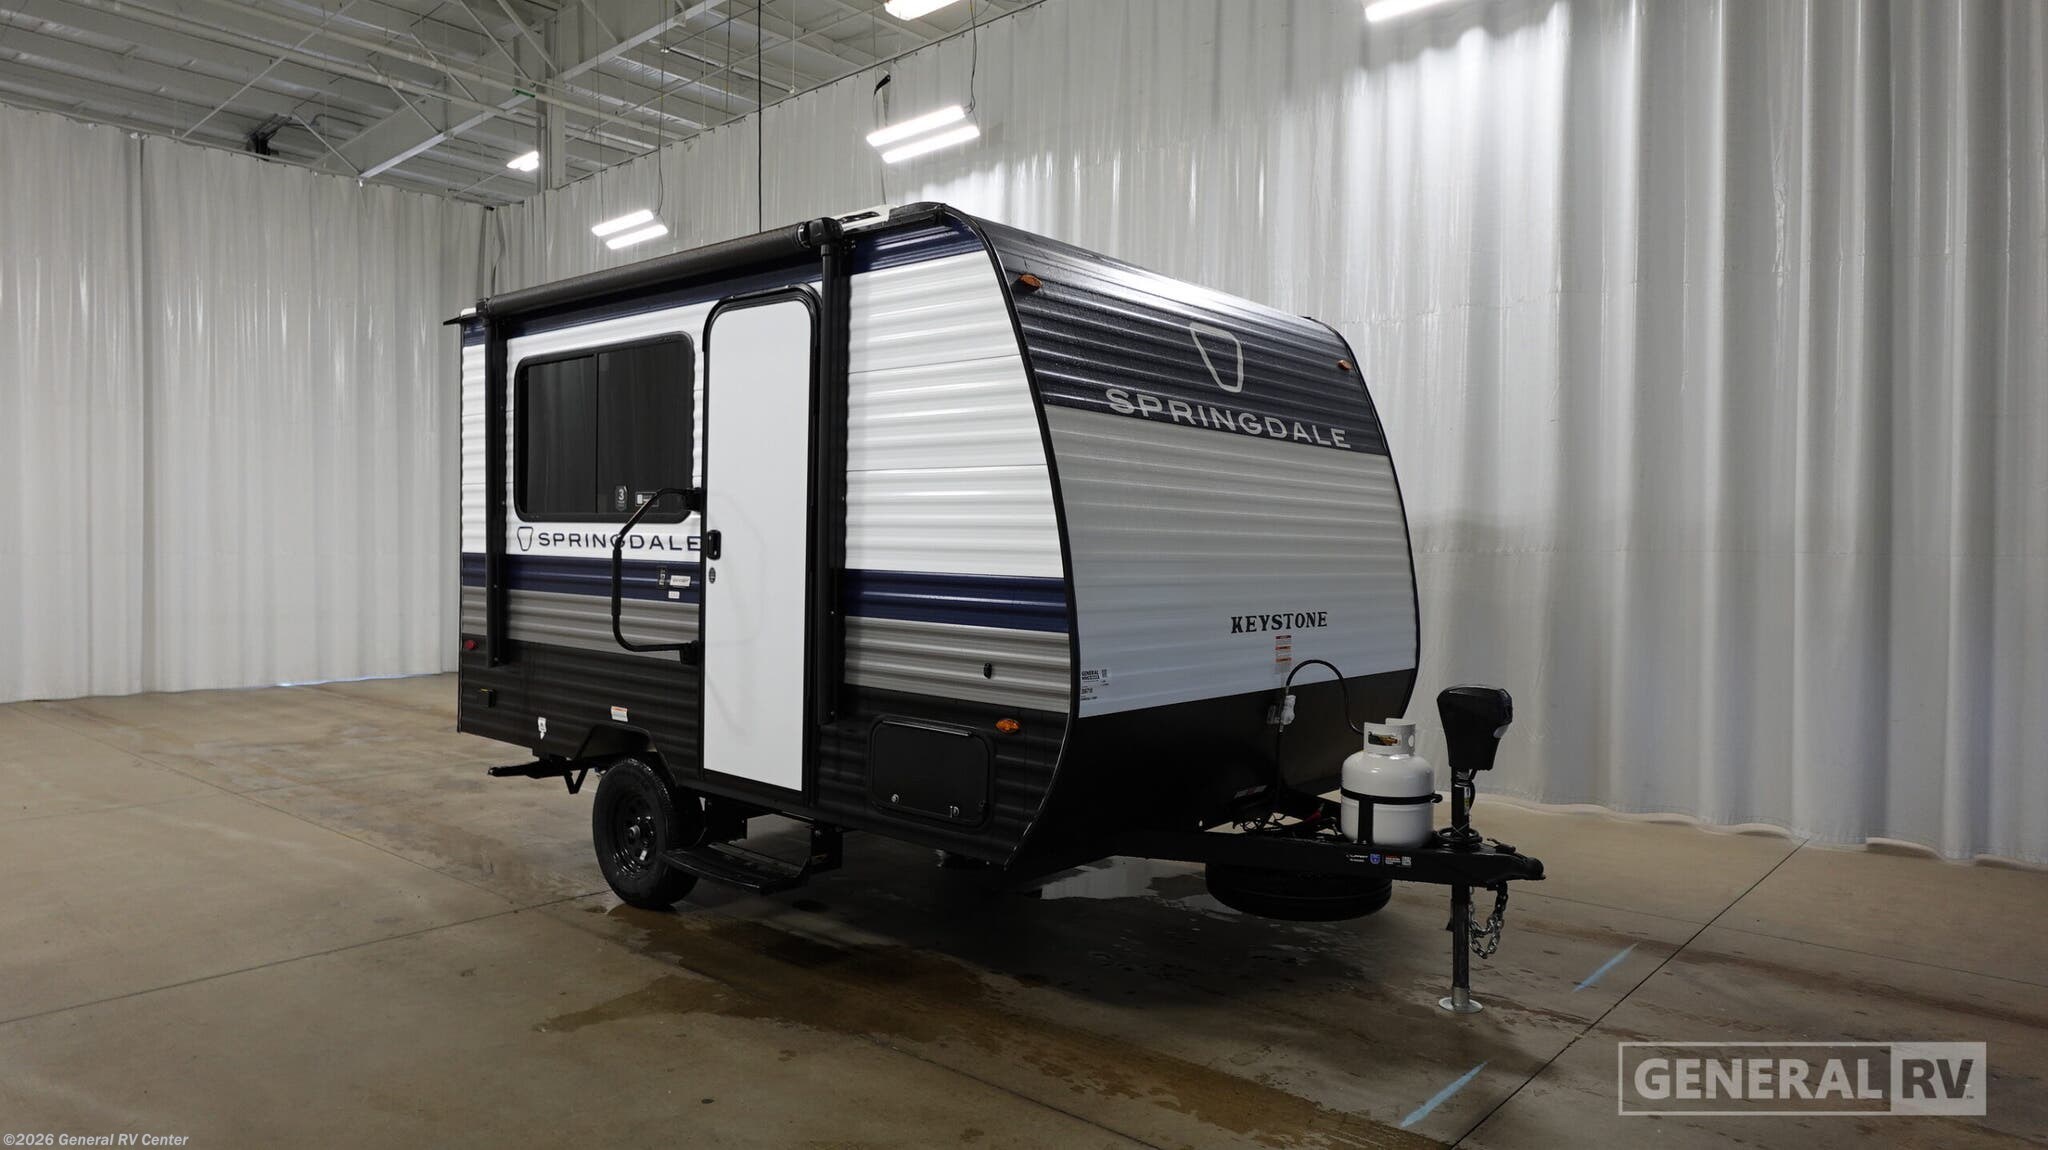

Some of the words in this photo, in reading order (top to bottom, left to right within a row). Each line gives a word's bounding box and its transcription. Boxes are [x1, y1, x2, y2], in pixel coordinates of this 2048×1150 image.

[1105, 388, 1352, 448] SPRINGDALE
[538, 532, 701, 552] SPRINGDALE
[1231, 611, 1328, 634] KEYSTONE
